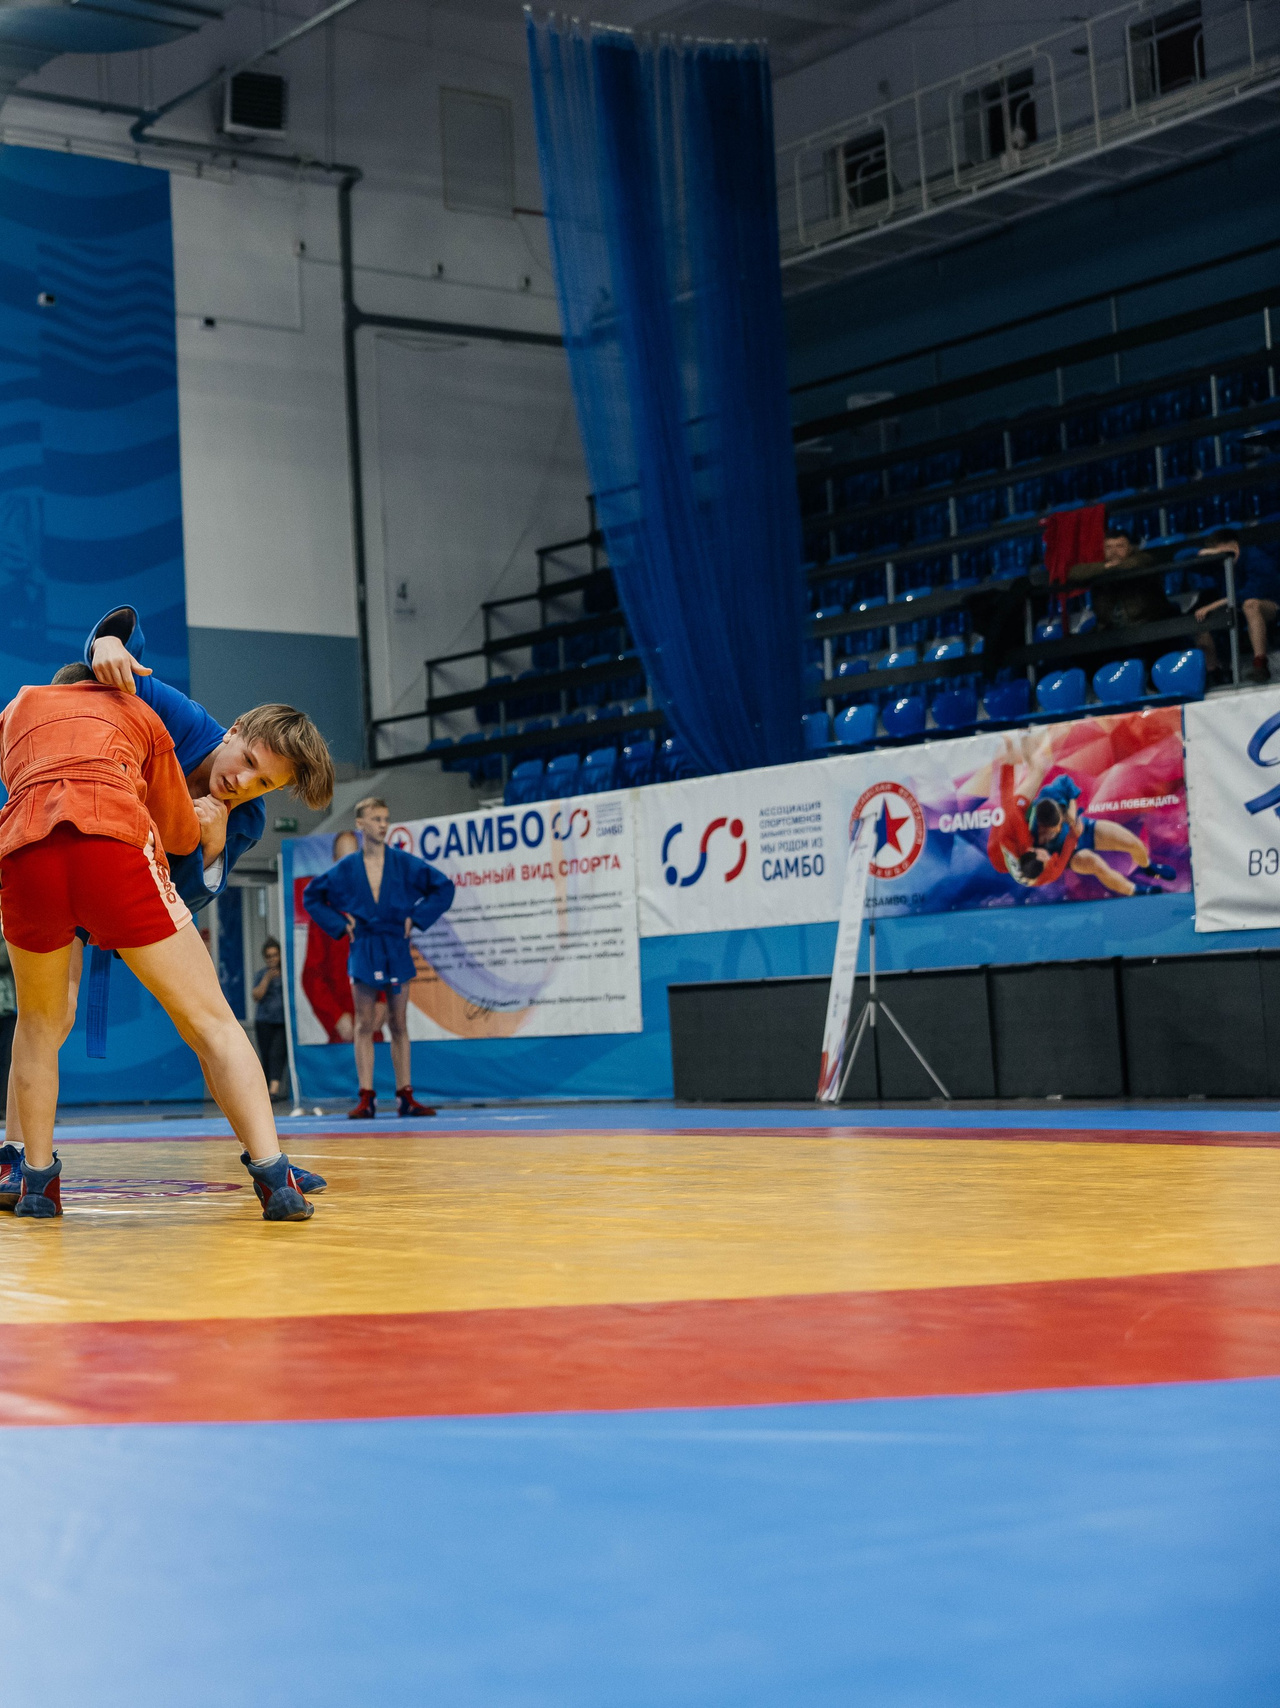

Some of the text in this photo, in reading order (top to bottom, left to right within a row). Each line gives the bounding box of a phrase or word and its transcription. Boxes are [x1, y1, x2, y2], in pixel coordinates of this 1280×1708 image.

[759, 800, 821, 816] АССОЦИАЦИЯ
[1088, 794, 1179, 813] НАУКА ПОБЕЖДАТЬ
[938, 806, 1005, 834] САМБО
[420, 810, 545, 861] САМБО
[450, 854, 621, 888] АЛЬНЫЙ ВИД СПОРТА
[762, 854, 824, 880] САМБО
